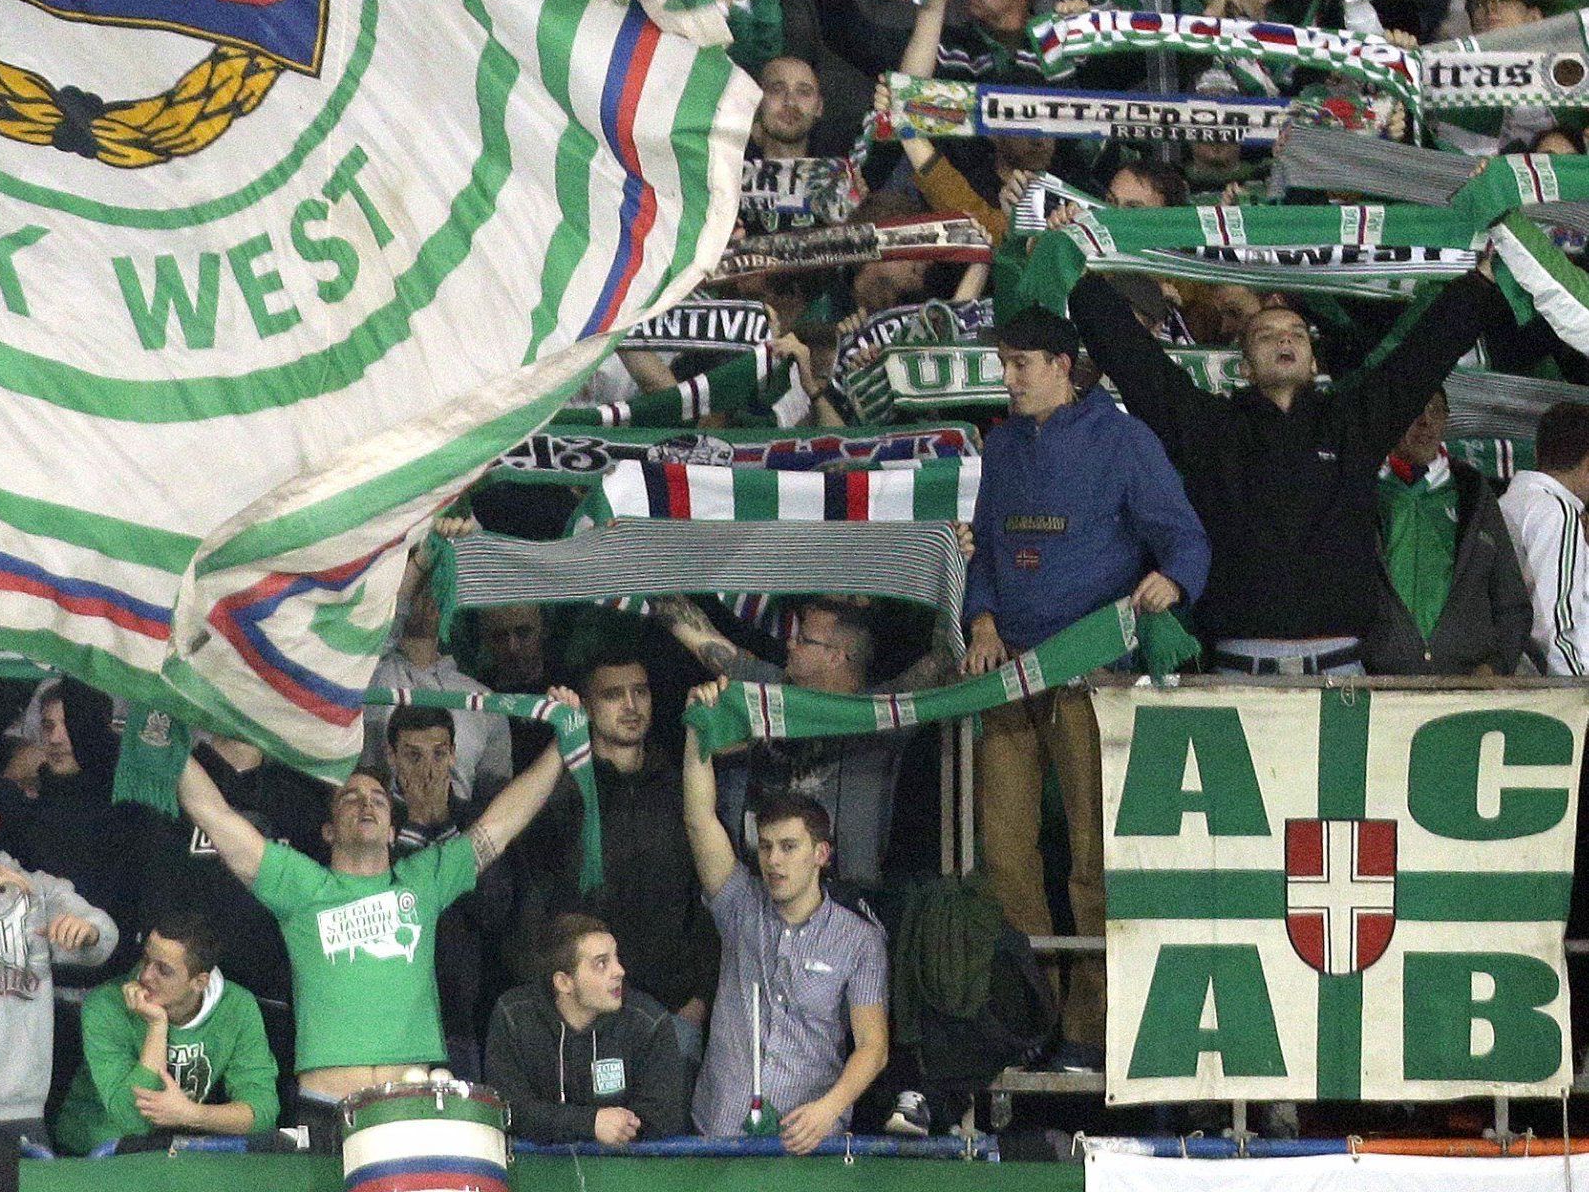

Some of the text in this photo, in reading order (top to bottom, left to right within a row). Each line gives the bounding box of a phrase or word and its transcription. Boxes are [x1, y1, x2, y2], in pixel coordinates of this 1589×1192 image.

[111, 143, 399, 354] WEST
[1112, 704, 1577, 842] A C
[1125, 943, 1564, 1084] A B
